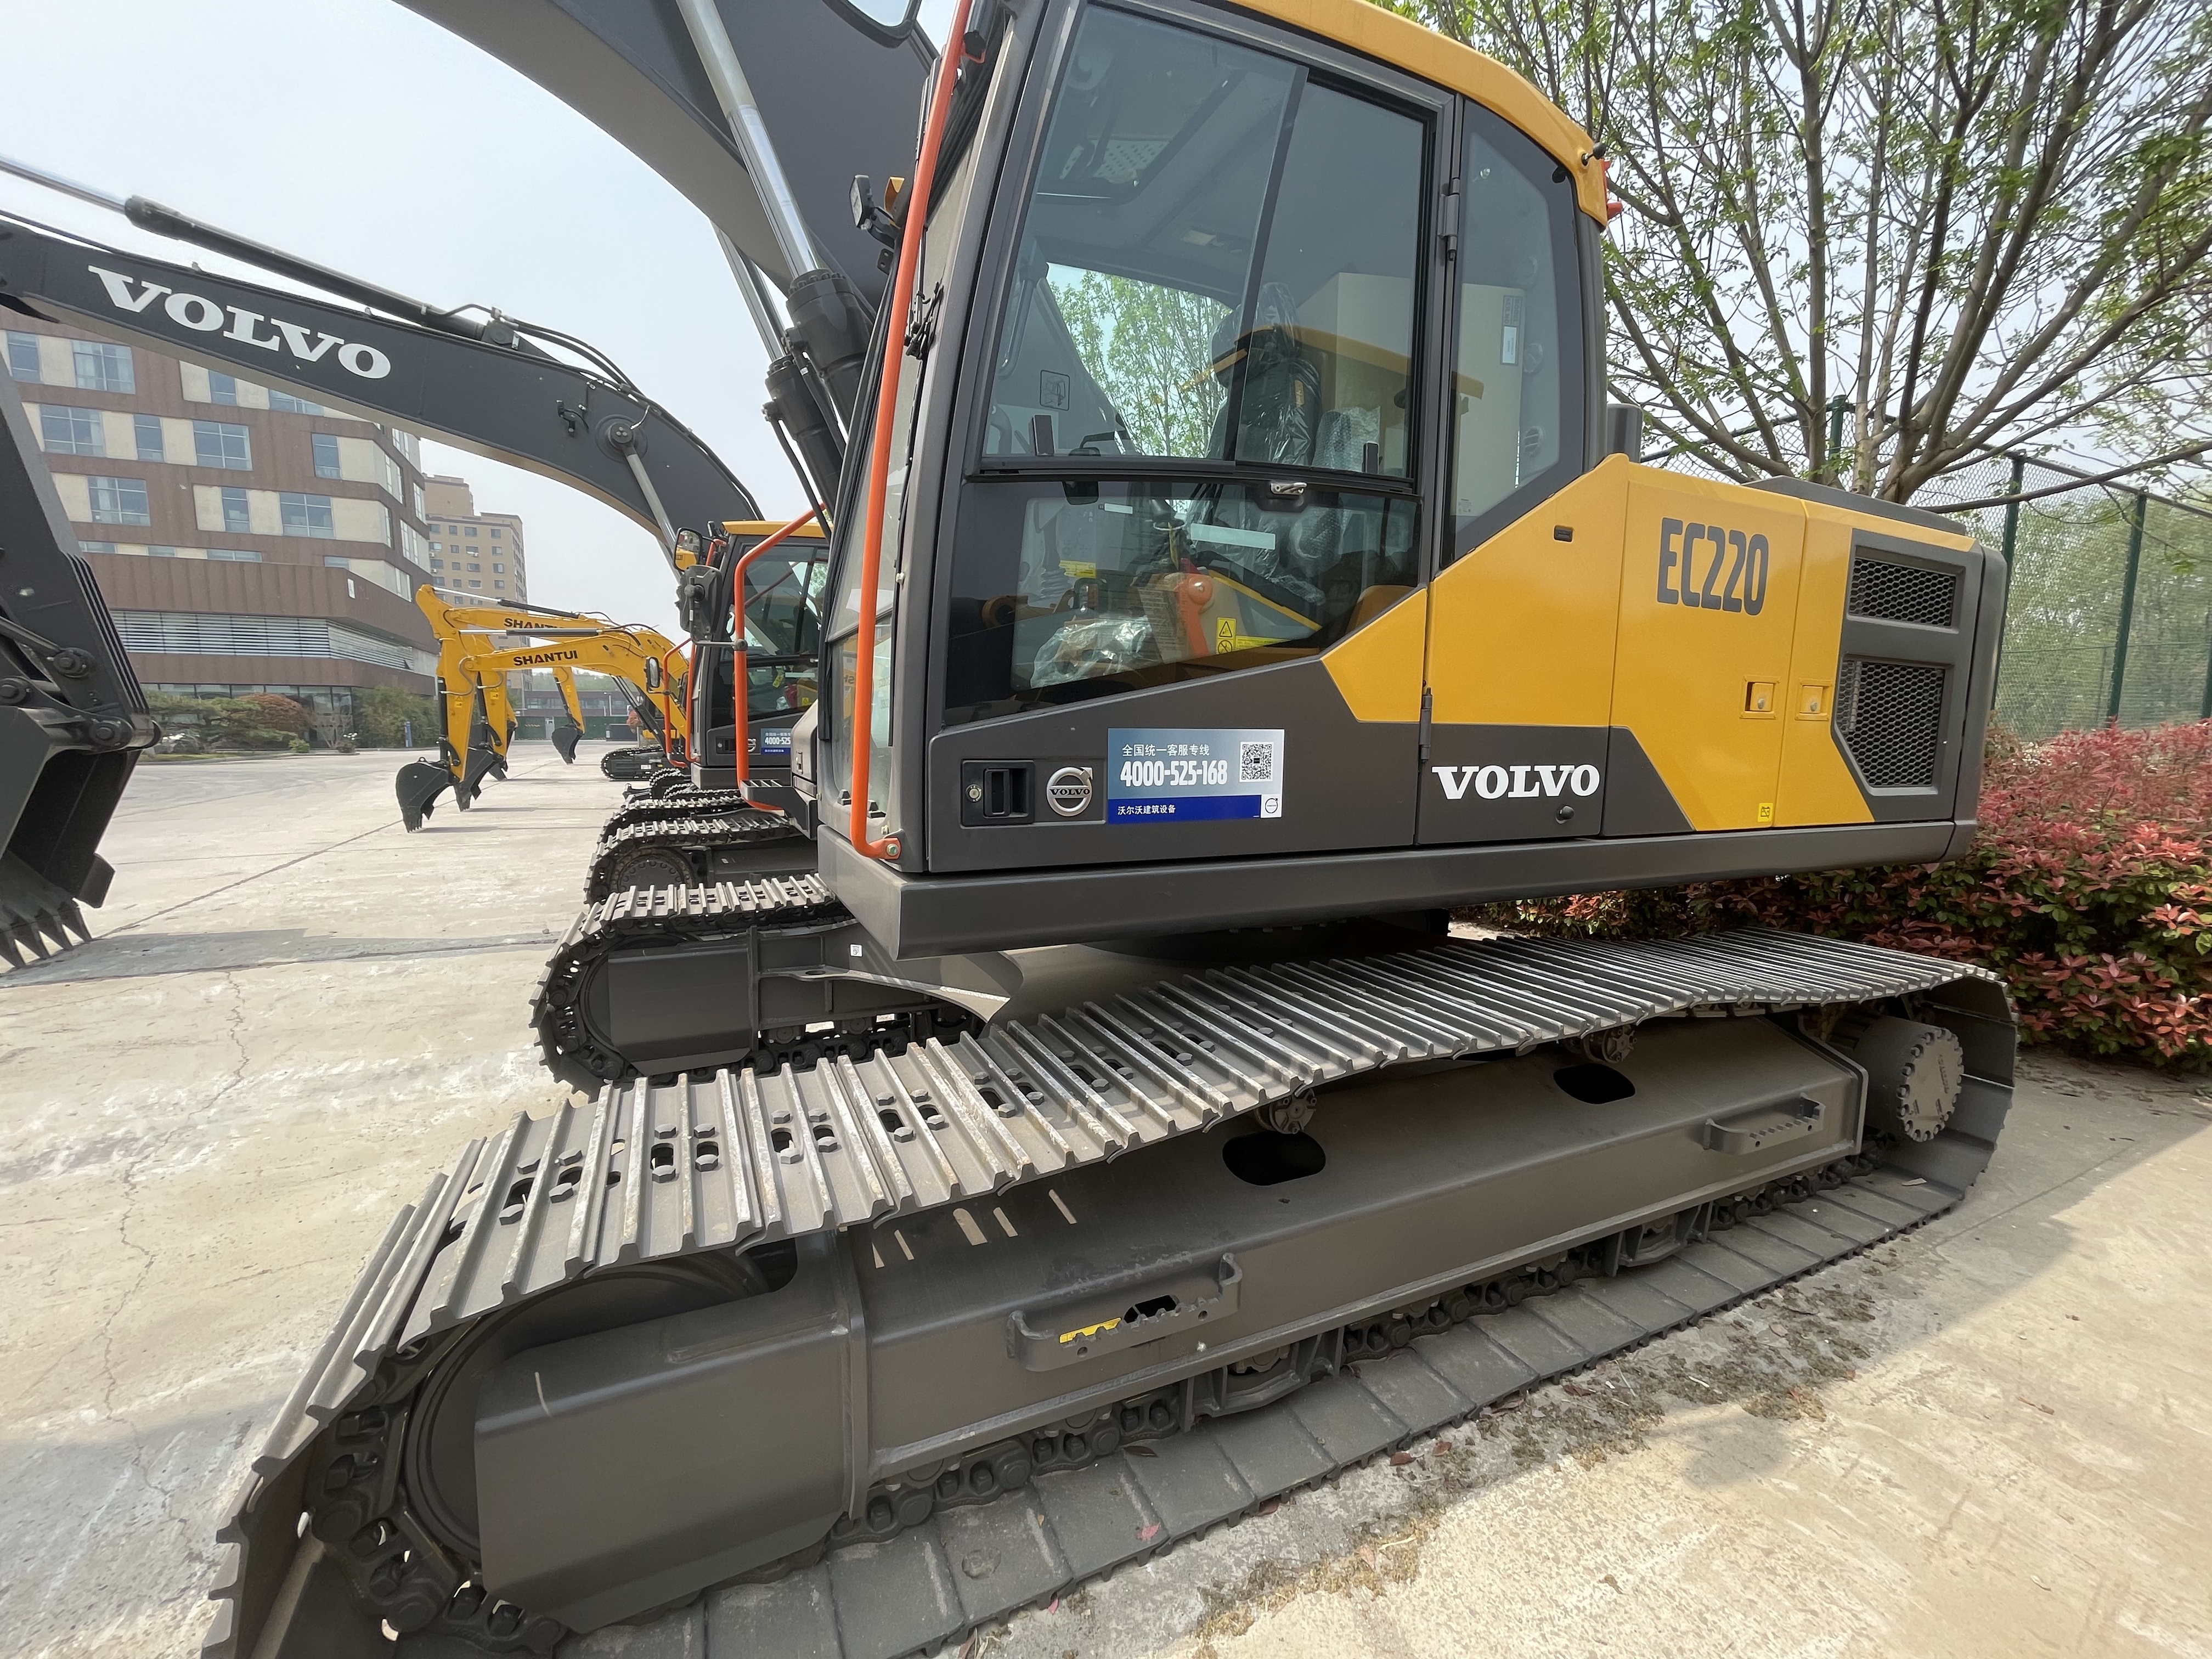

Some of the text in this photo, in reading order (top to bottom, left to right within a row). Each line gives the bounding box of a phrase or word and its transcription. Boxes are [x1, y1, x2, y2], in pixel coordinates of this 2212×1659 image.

[88, 265, 391, 379] VOLVO
[1657, 517, 1769, 616] EC220
[513, 650, 578, 666] SHANTUI
[1122, 744, 1210, 757] 全国统一客服专线
[1120, 760, 1228, 787] 4000-525-168
[1431, 764, 1600, 800] VOLVO
[1118, 805, 1176, 815] 沃尔沃建筑设备
